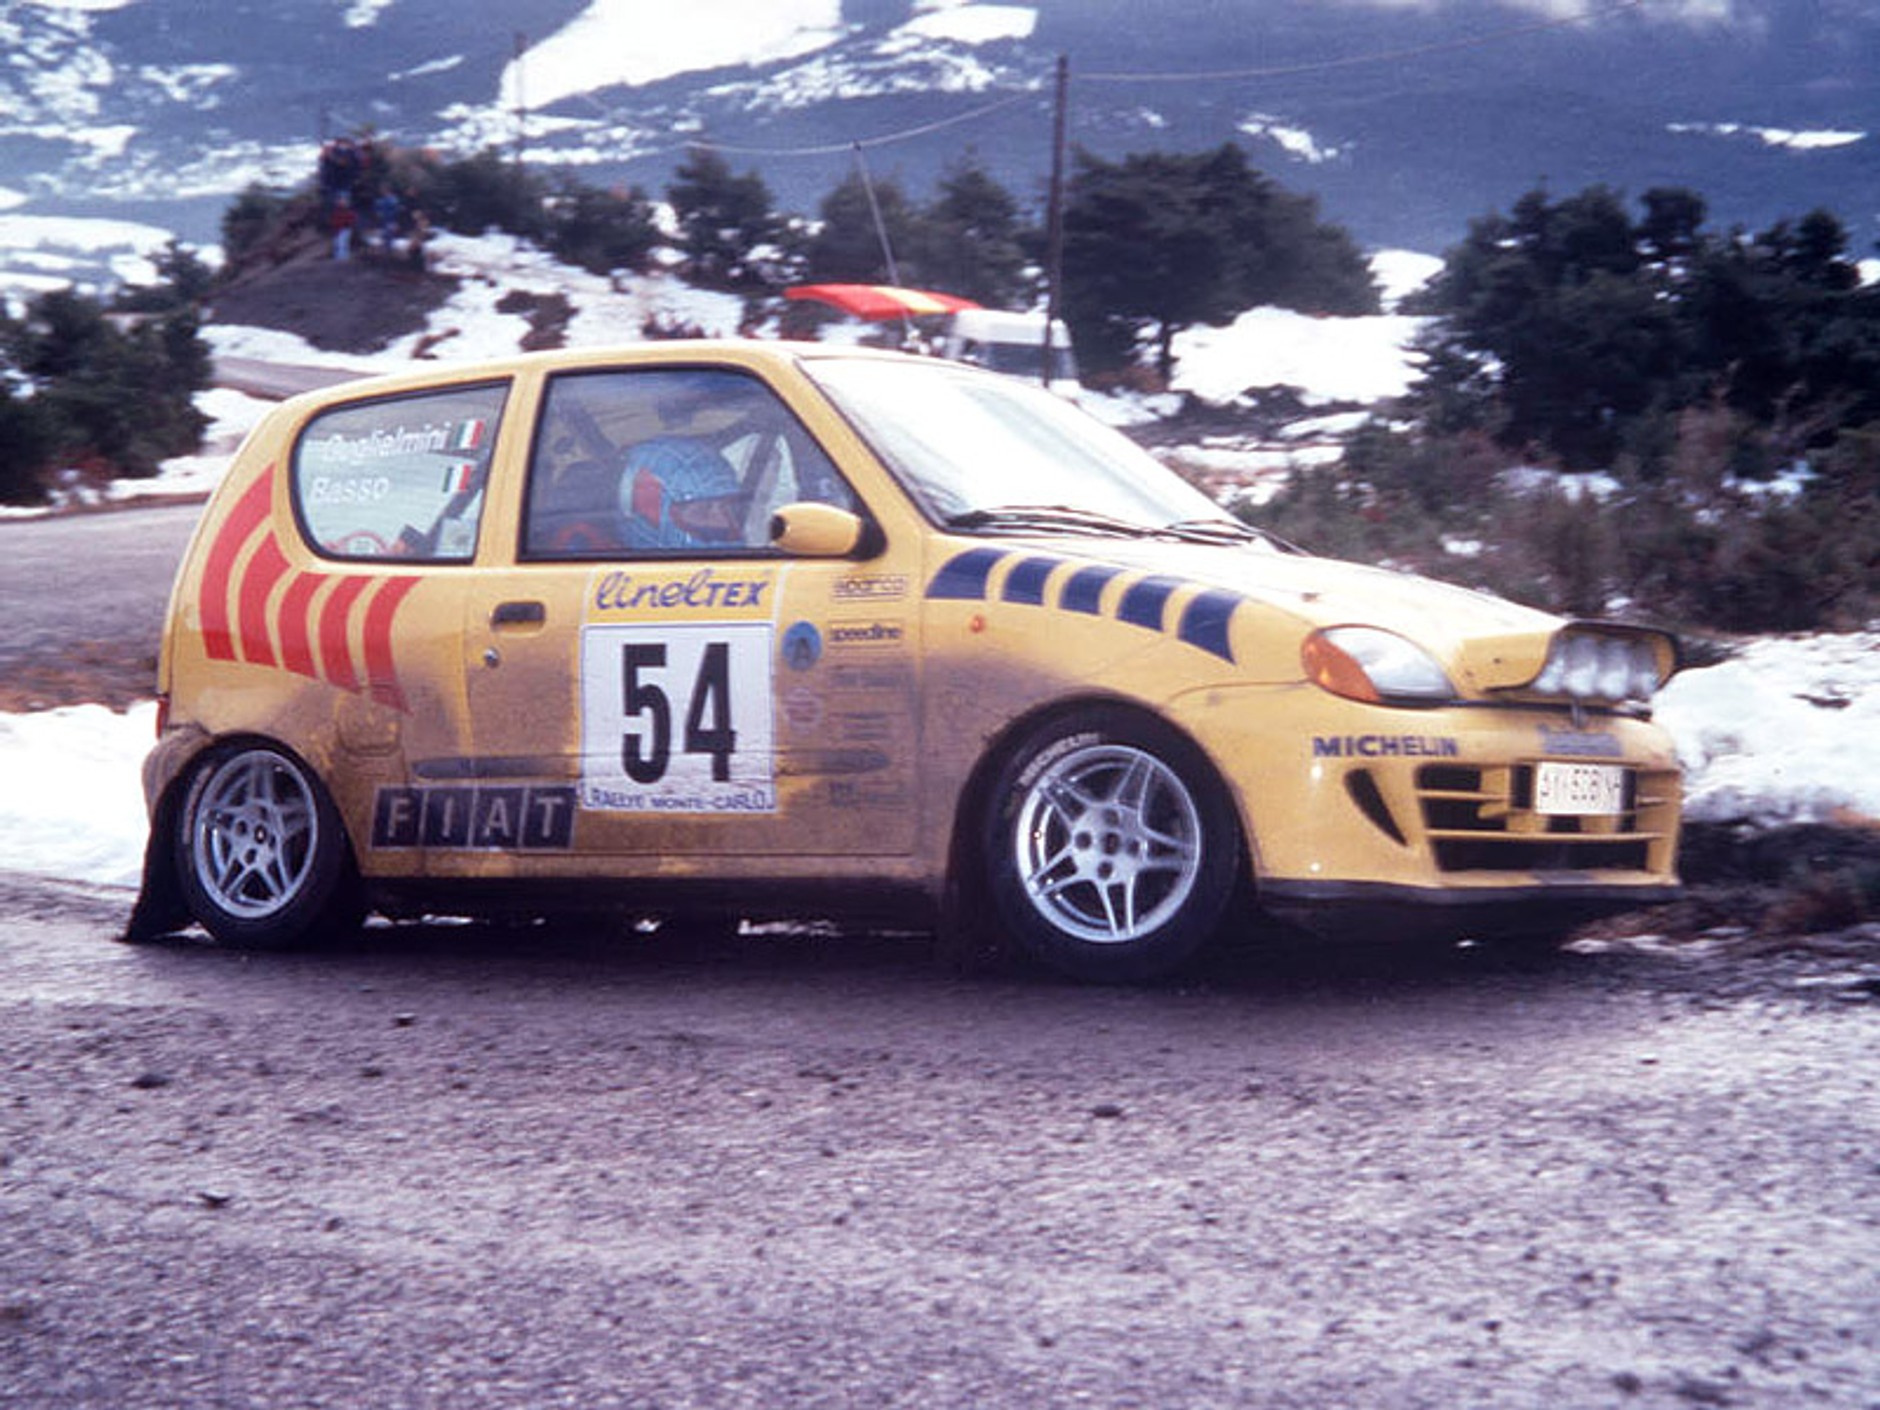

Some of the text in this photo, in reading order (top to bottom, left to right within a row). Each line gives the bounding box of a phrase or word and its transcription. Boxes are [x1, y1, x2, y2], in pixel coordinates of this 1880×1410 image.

[621, 641, 738, 785] 54
[1312, 735, 1460, 758] MICHELIN
[385, 795, 565, 840] FIAT
